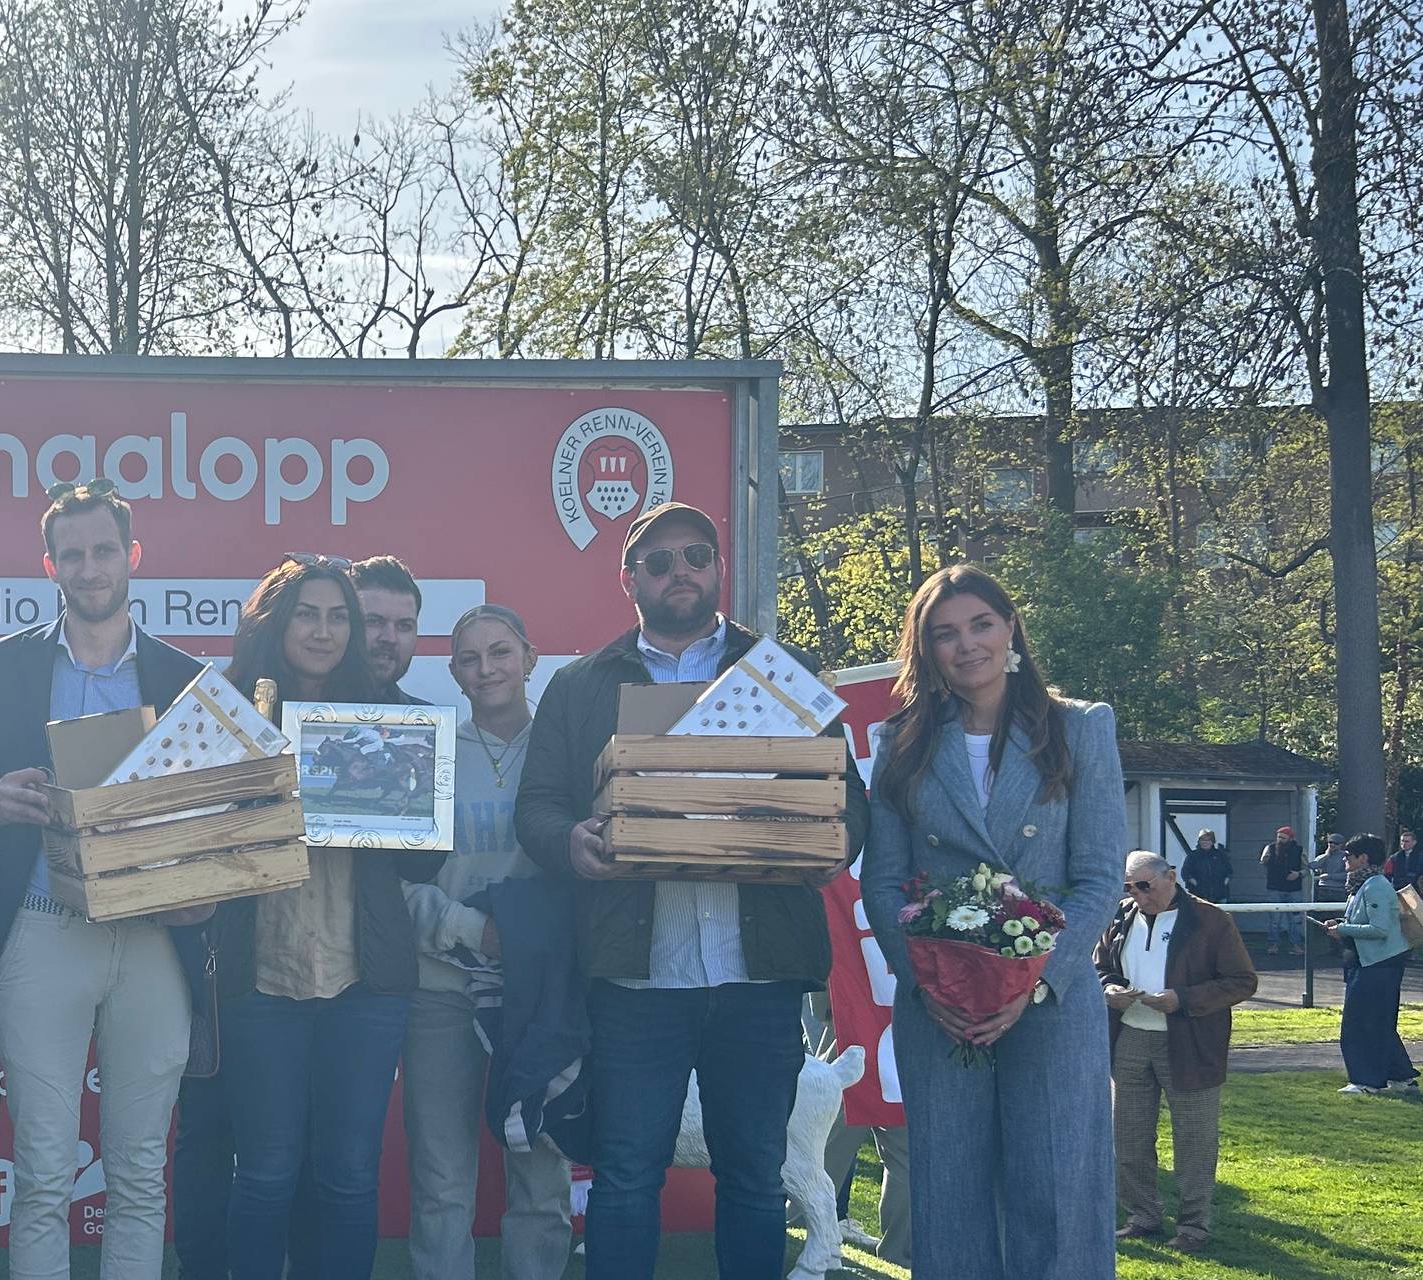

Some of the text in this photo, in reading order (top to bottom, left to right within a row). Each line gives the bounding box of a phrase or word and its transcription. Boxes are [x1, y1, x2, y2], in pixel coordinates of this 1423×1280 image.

[559, 414, 667, 524] KOELNER RENN-VEREIN 18
